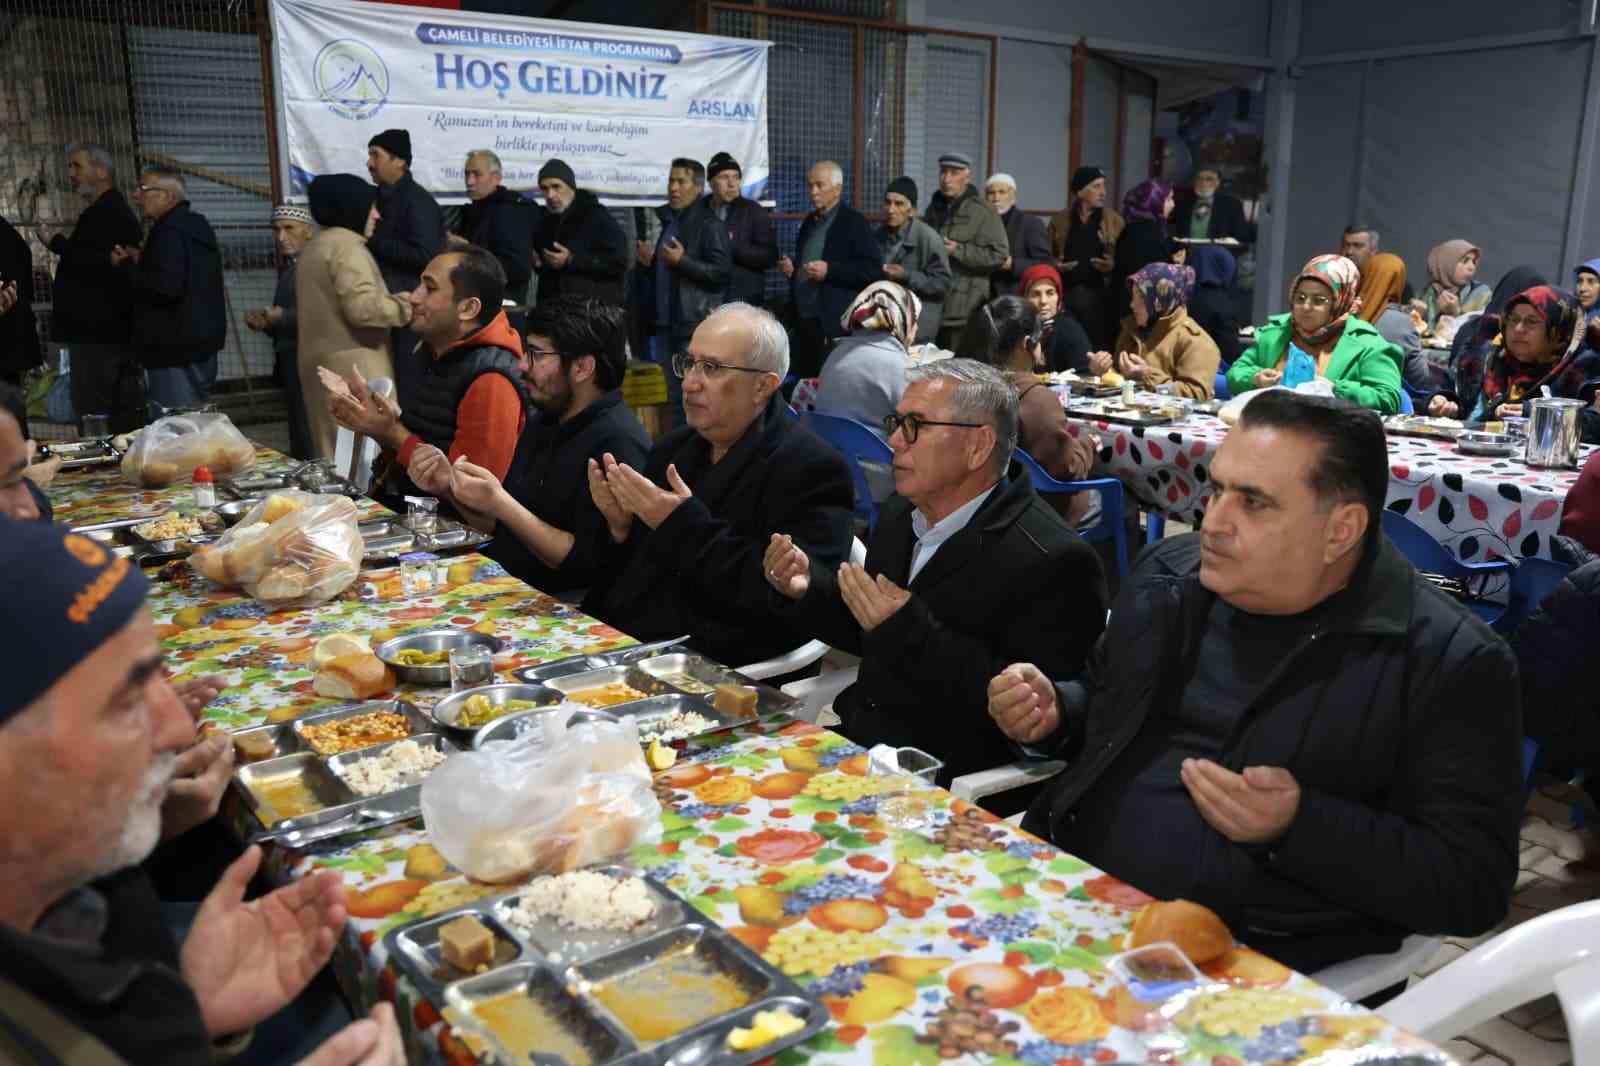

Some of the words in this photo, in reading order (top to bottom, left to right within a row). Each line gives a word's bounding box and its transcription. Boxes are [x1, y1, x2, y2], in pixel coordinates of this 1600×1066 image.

[428, 27, 479, 43] ÇAMELİ
[483, 31, 554, 49] BELEDİYESİ
[556, 35, 590, 52] İFTAR
[593, 41, 673, 59] PROGRAMINA
[687, 99, 754, 118] ARSLAN
